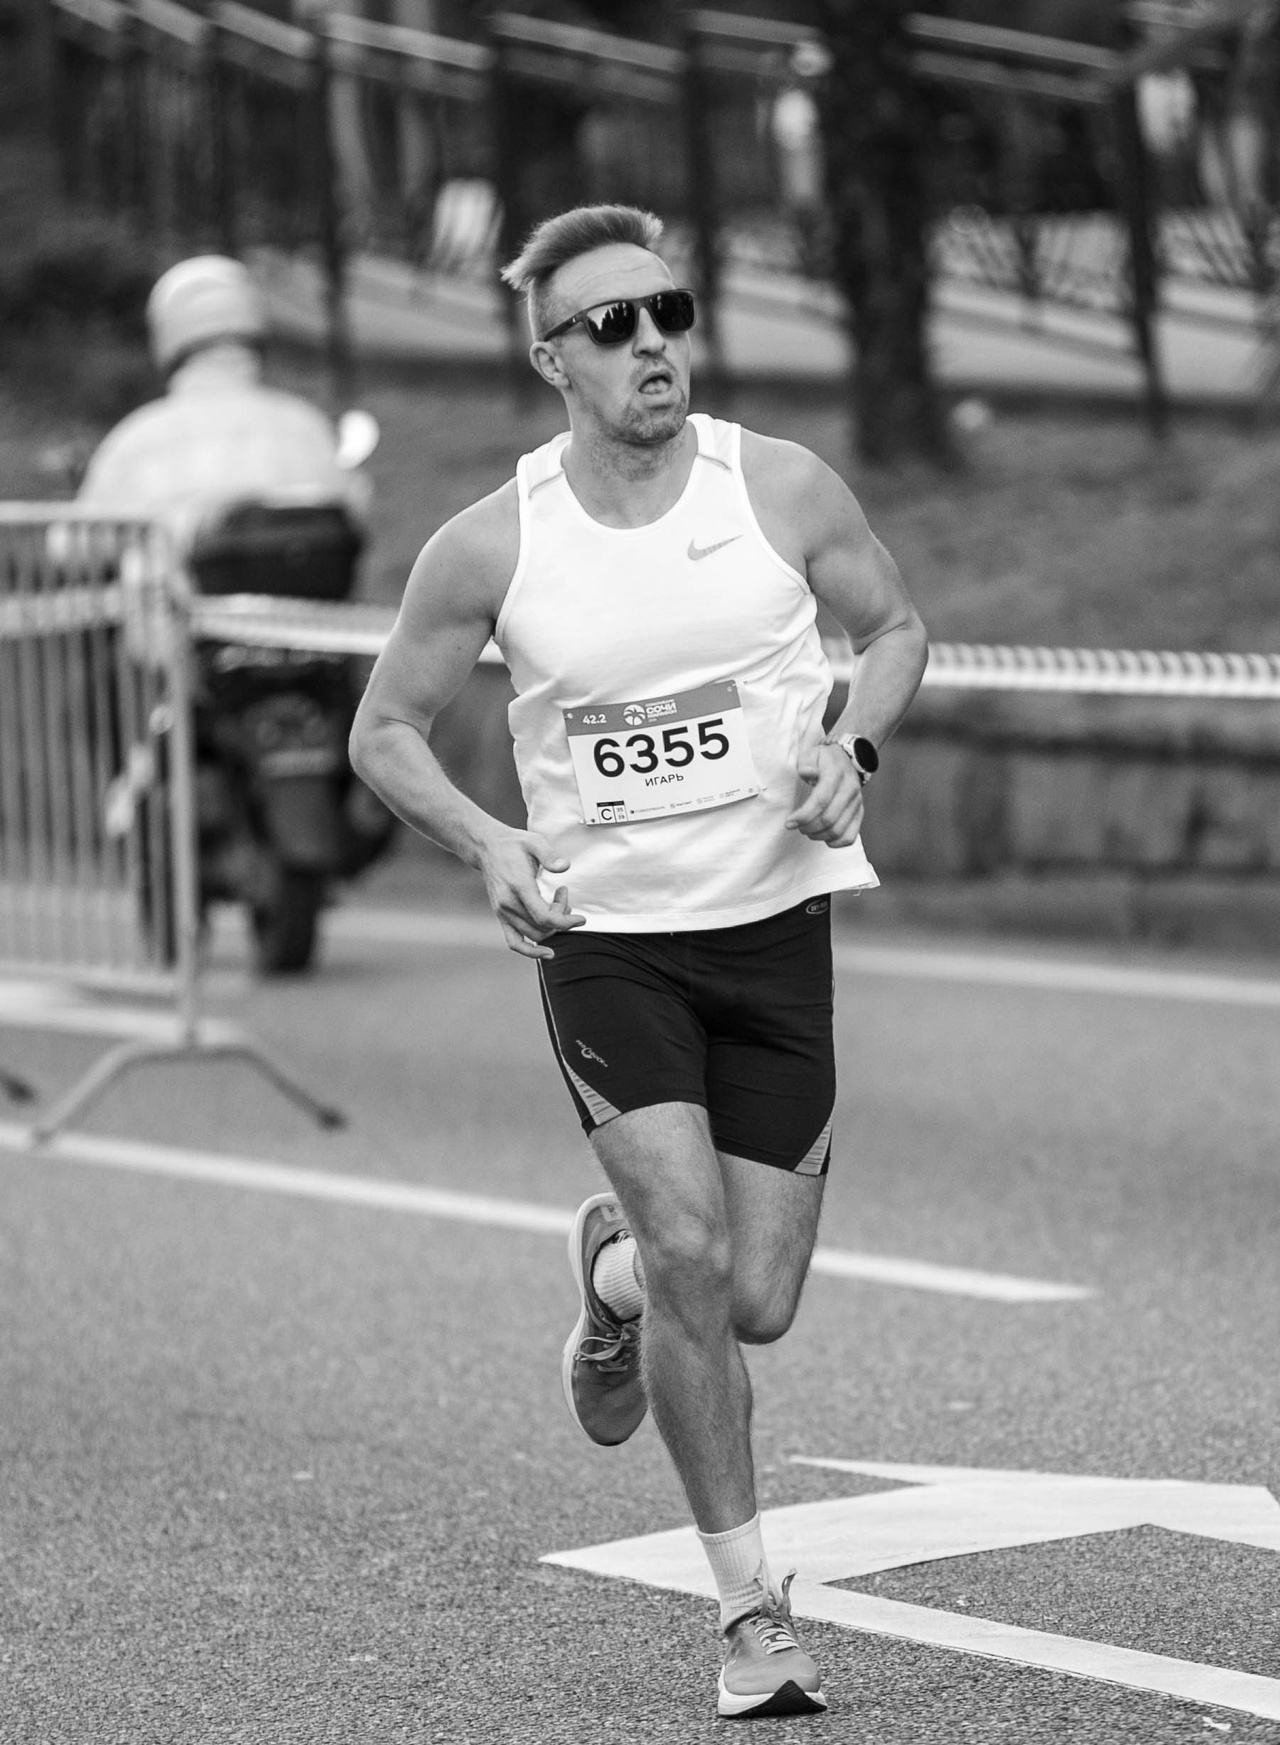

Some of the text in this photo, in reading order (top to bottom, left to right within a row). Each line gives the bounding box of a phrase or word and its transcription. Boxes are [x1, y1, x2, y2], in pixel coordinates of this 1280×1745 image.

[645, 702, 677, 714] СОЧИ
[582, 713, 607, 725] 42.2
[593, 718, 730, 778] 6355
[645, 773, 684, 787] ИГАРЬ
